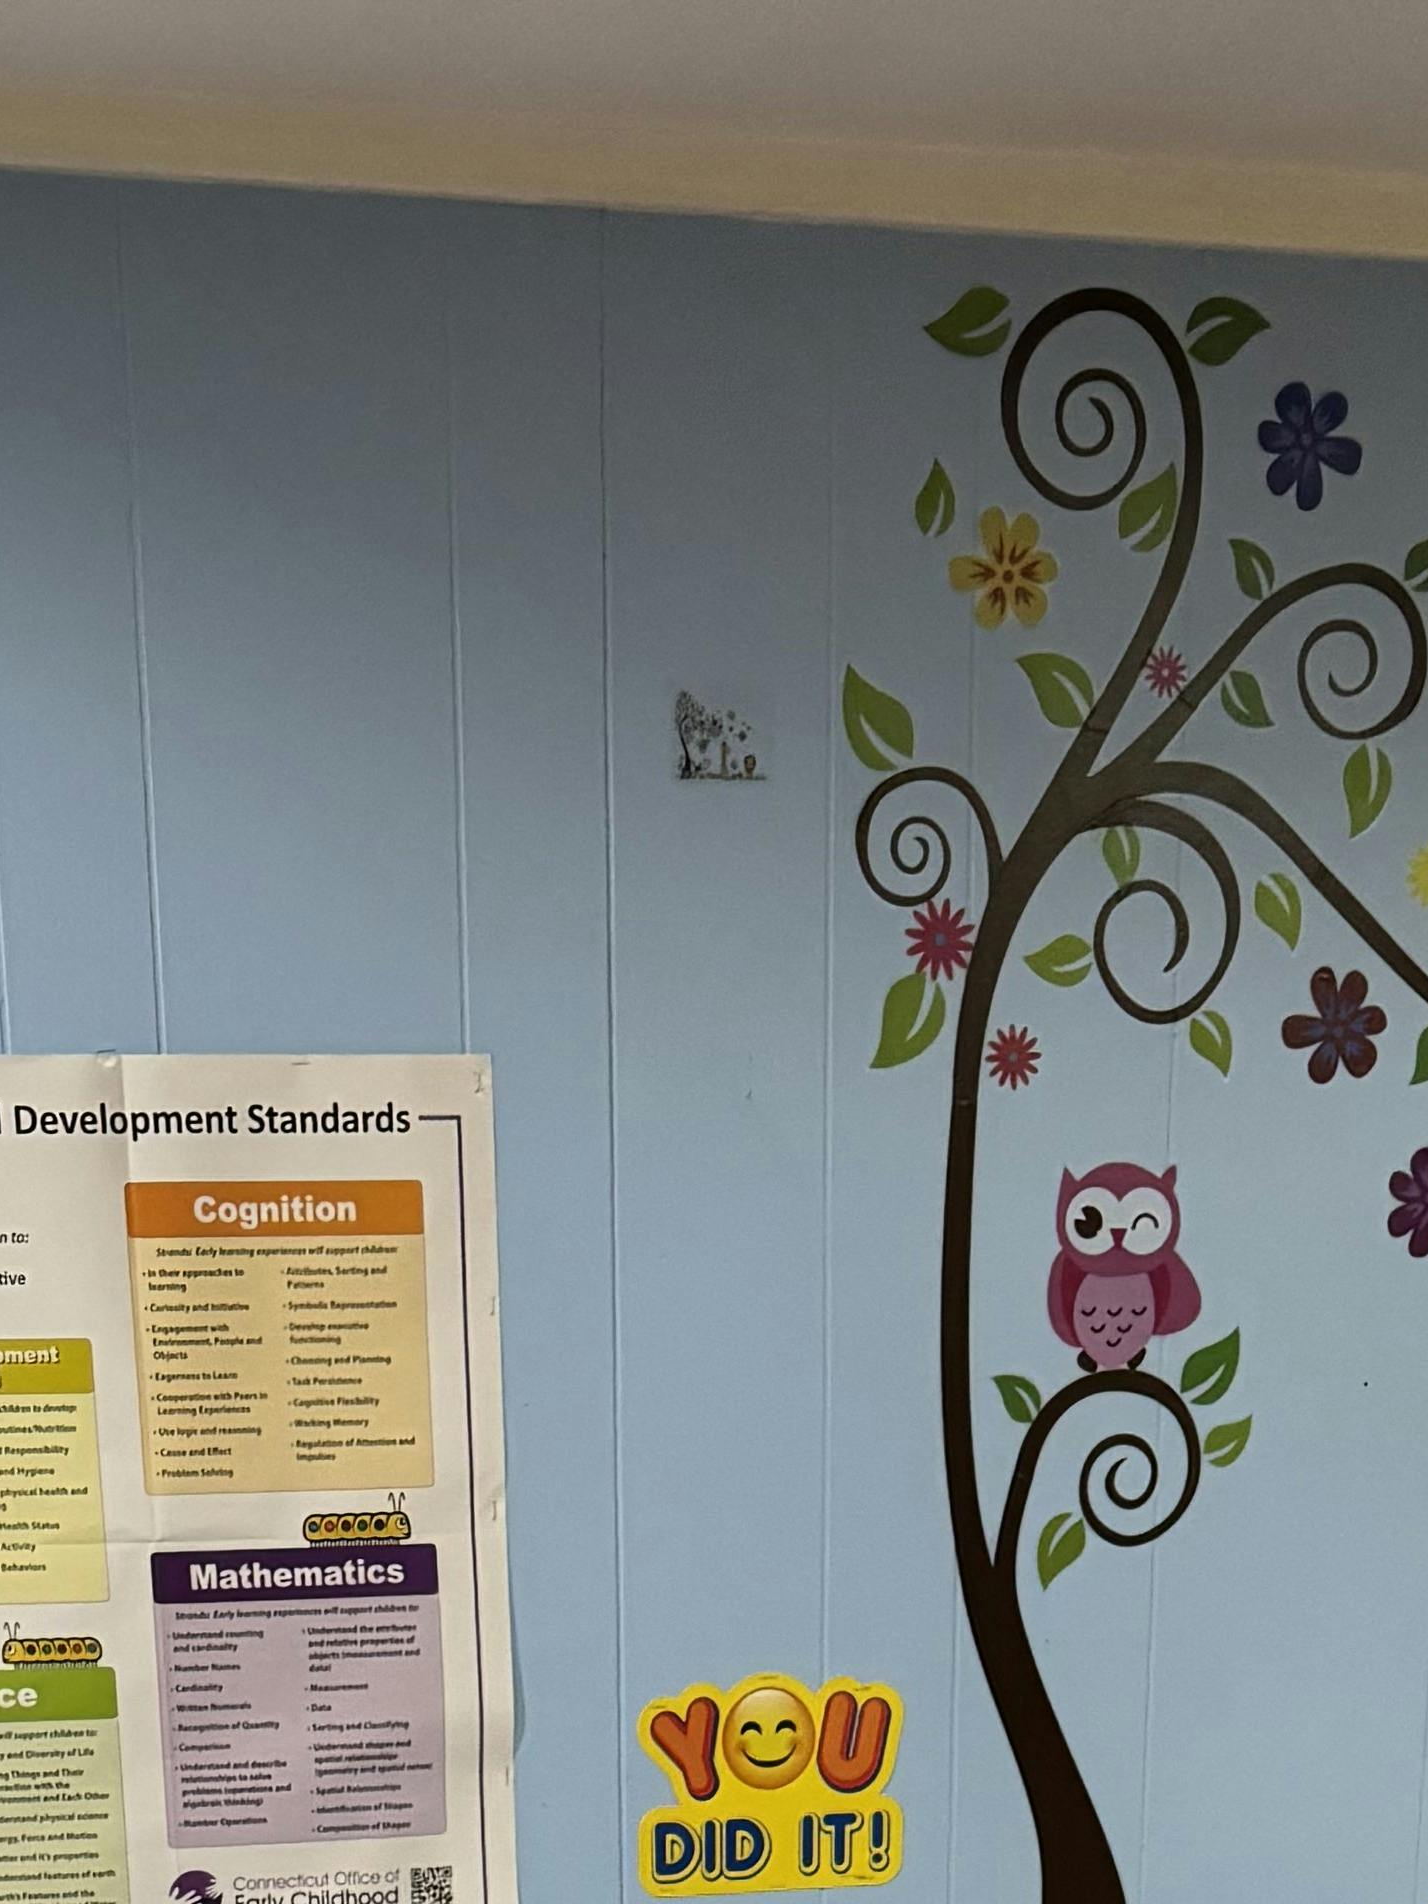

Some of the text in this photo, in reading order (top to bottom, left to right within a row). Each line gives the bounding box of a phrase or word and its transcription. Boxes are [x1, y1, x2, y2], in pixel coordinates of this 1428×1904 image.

[14, 1103, 237, 1140] Development
[248, 1102, 410, 1133] Standards
[194, 1195, 355, 1229] Cognition
[11, 1232, 28, 1243] to:
[190, 1558, 403, 1589] Mathematics
[653, 1810, 890, 1883] DID IT!
[232, 1867, 400, 1891] Connecticut Office of
